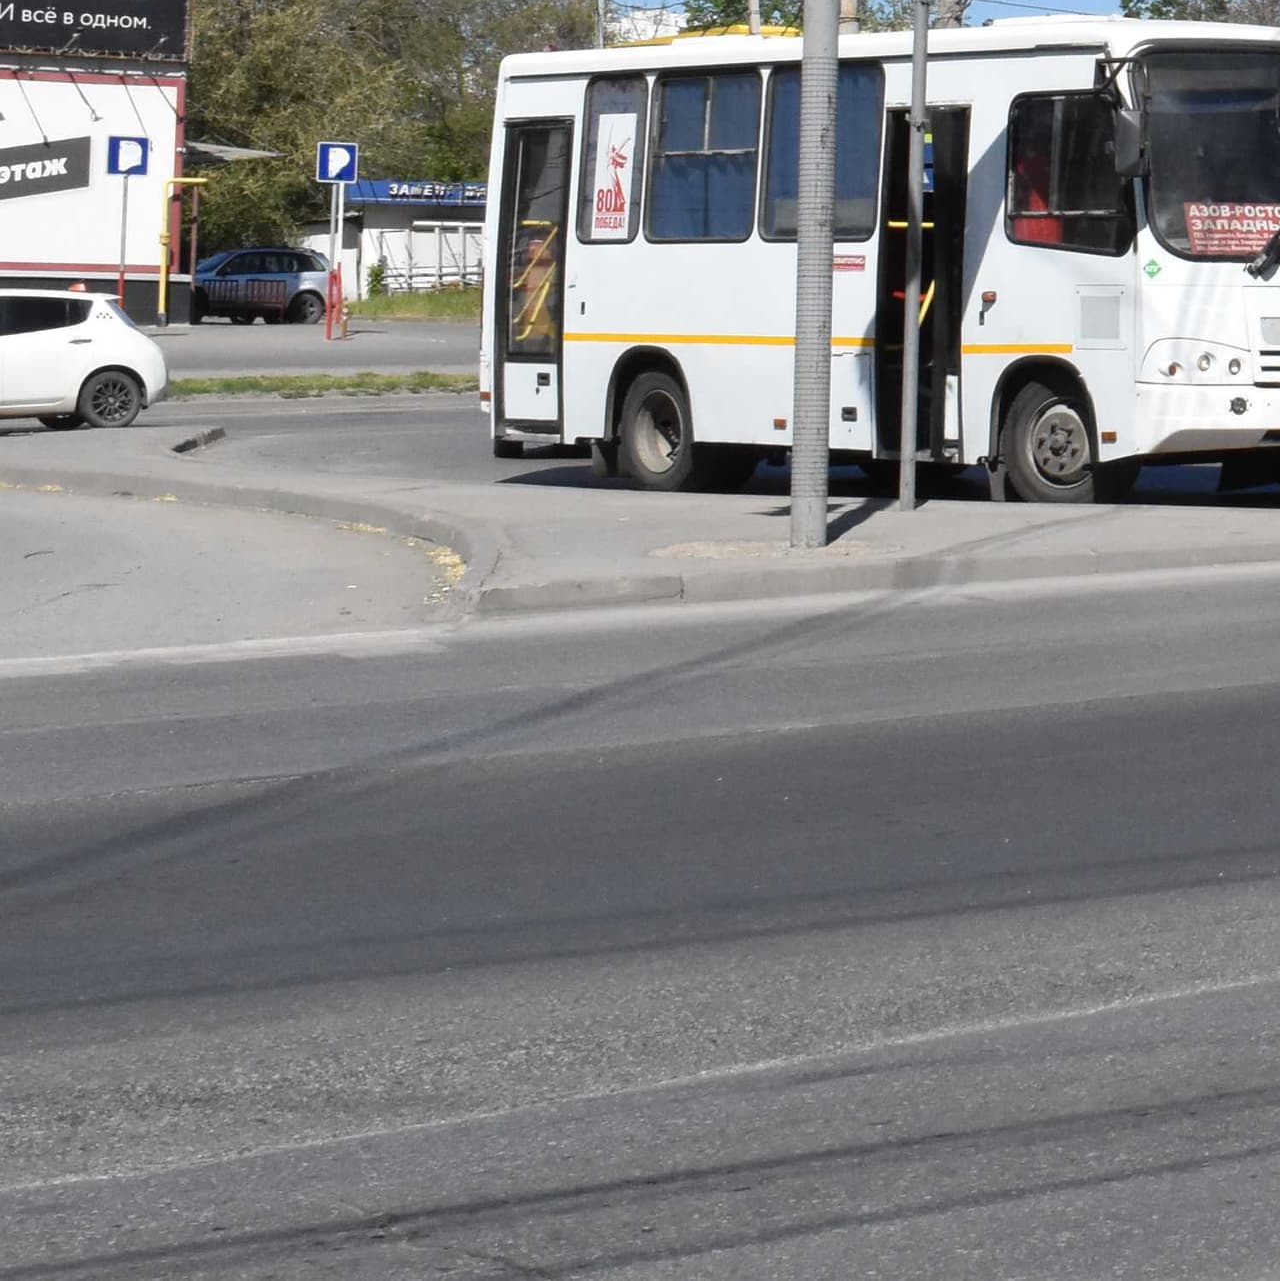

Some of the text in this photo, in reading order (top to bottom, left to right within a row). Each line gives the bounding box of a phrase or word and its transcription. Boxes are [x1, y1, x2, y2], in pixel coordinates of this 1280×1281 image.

[21, 6, 57, 23] всё
[63, 11, 74, 25] в
[80, 13, 152, 30] одном.
